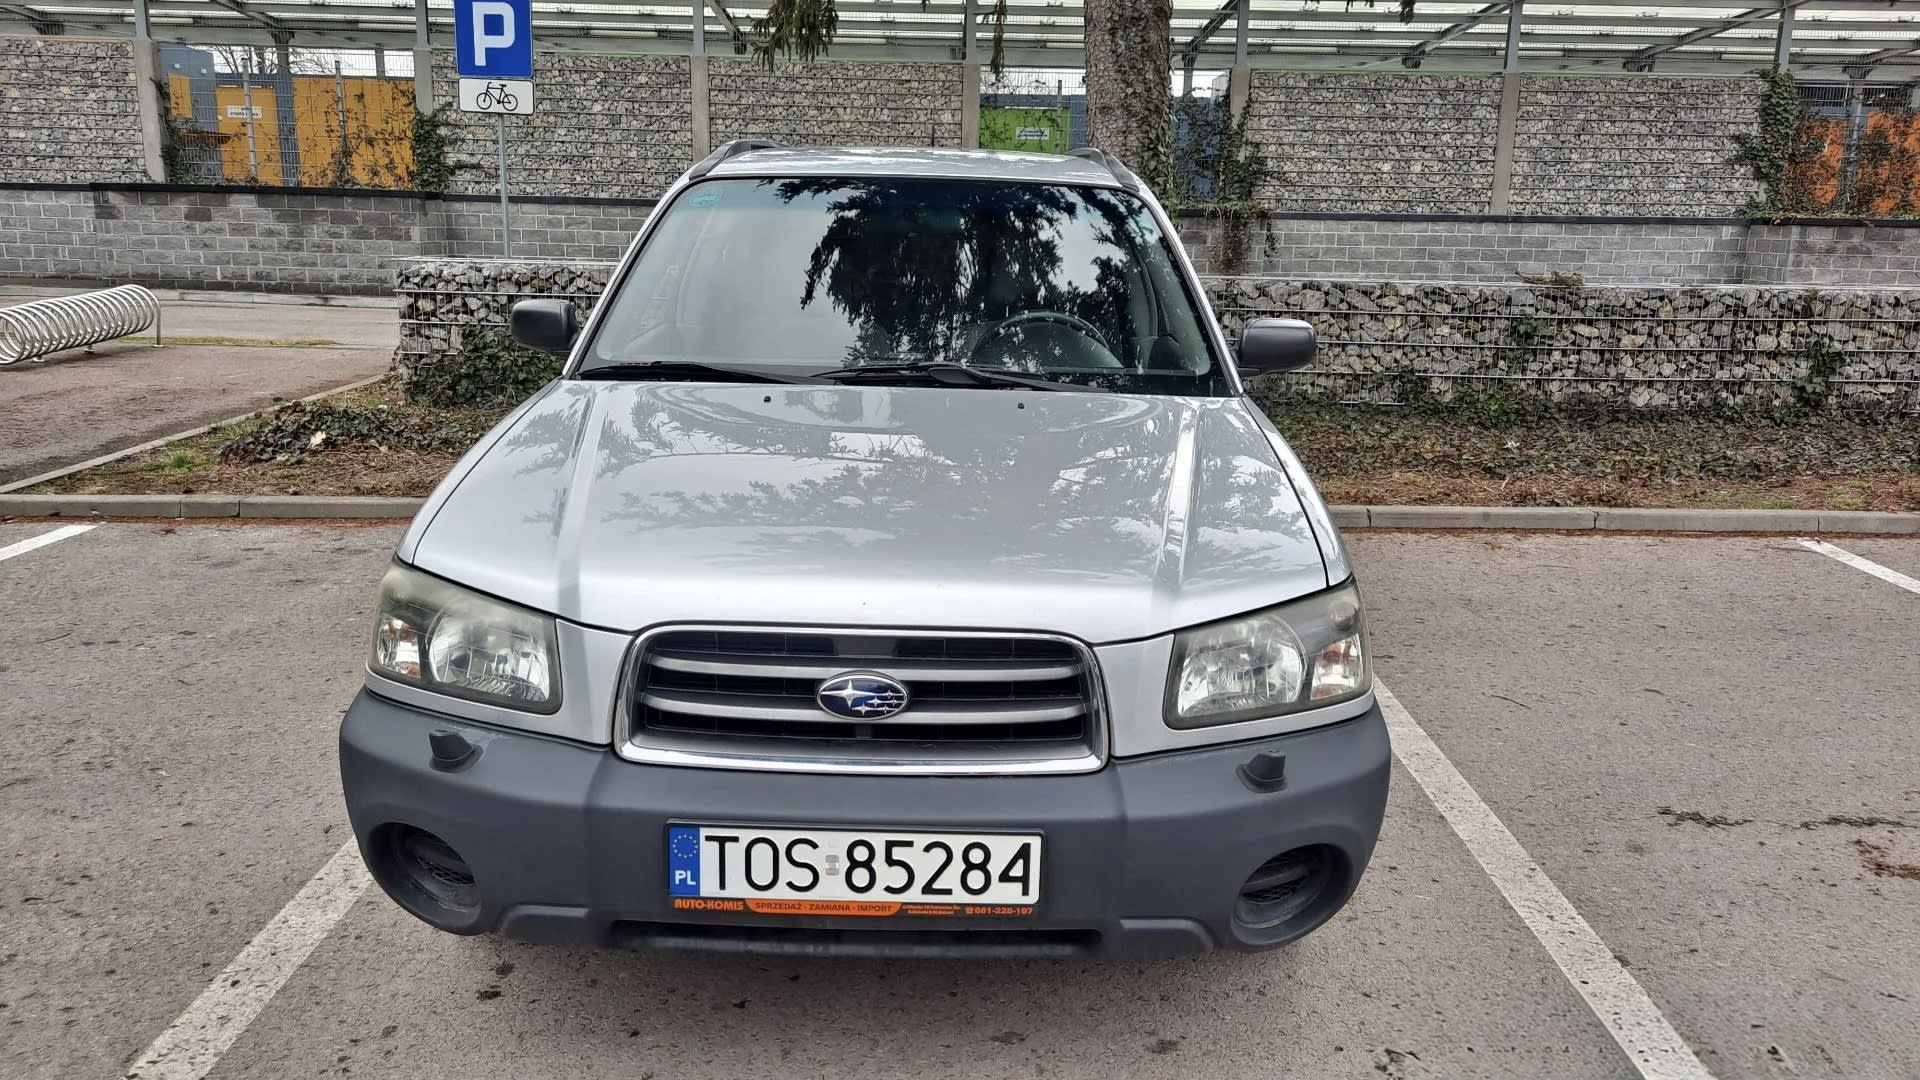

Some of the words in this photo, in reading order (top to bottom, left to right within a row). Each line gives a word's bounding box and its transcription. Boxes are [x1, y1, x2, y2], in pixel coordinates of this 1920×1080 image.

[472, 2, 515, 66] P
[705, 835, 820, 892] TOS
[845, 839, 1031, 896] 85284
[675, 870, 697, 885] PL
[675, 899, 744, 911] AUTO-KOMIS
[755, 902, 802, 911] SPRZEDAŻ
[809, 903, 850, 912] ZAMIANA
[857, 904, 892, 912] IMPORT
